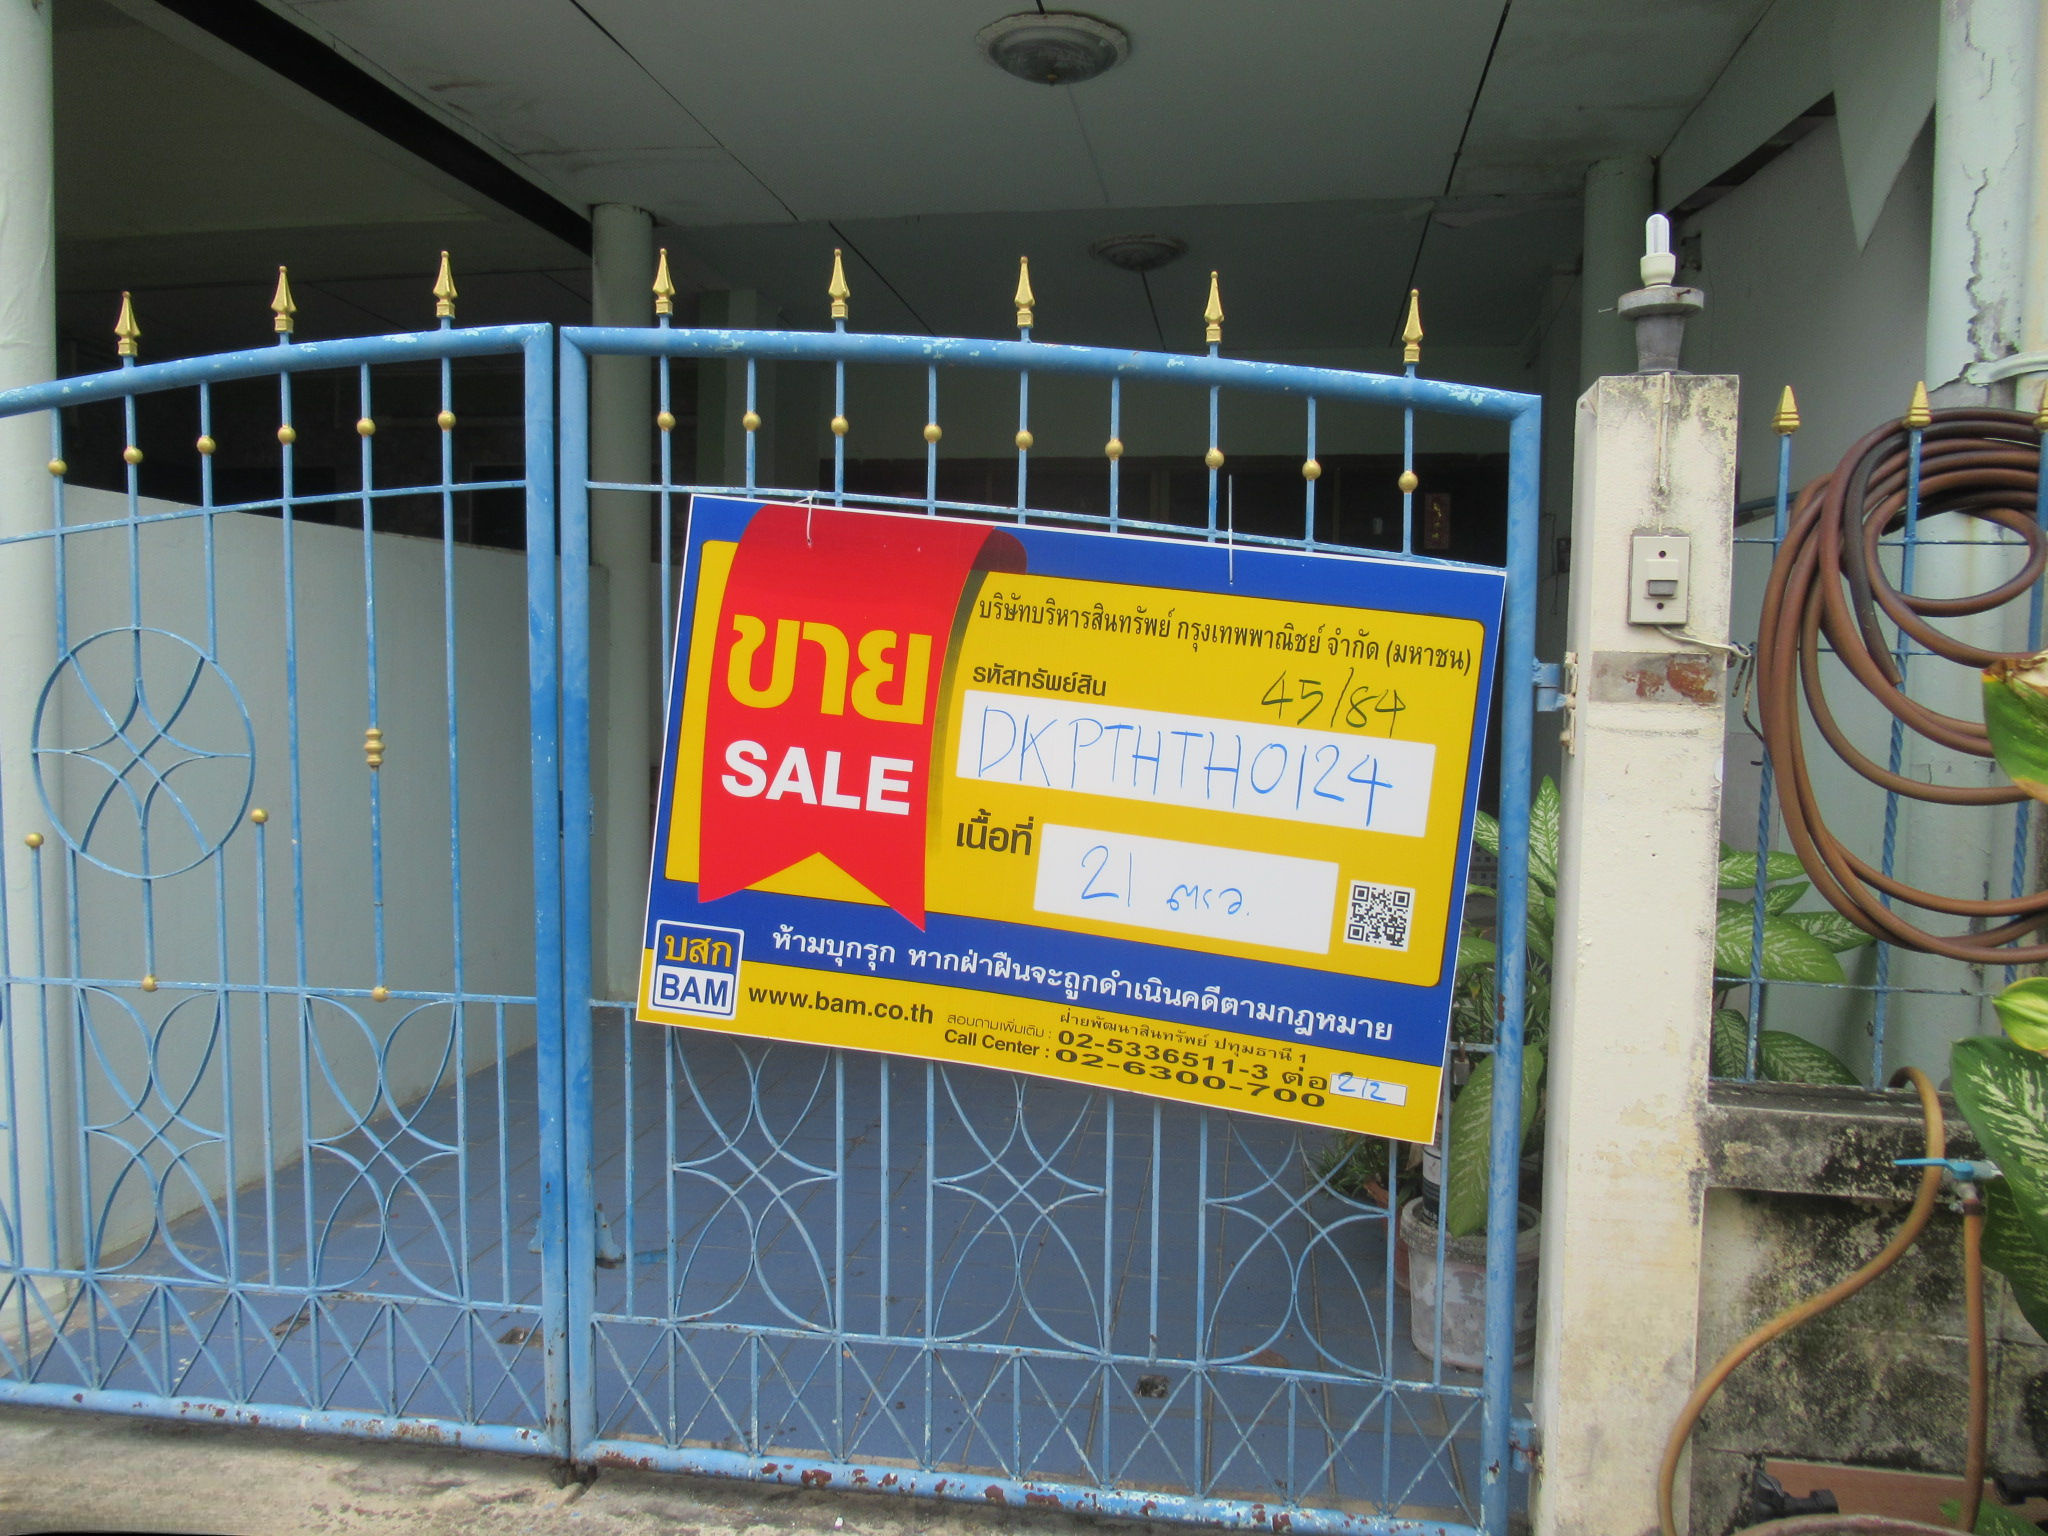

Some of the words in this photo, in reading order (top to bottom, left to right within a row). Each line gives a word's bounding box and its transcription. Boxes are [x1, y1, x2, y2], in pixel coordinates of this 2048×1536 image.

[979, 591, 1176, 638] บริษัทบริหารสินทรัพย์
[1177, 620, 1326, 654] กรุงเทพพาณิชย์
[1327, 627, 1379, 661] จำกัด
[1386, 640, 1471, 676] (มหาชน)
[727, 614, 932, 725] ขาย
[972, 662, 1107, 696] รหัสทรัพย์สิน
[1261, 667, 1406, 738] 45/84
[721, 739, 914, 816] SALE
[956, 808, 1034, 856] เนื้อที่
[1080, 845, 1133, 907] 21
[664, 934, 733, 967] บสก
[772, 923, 896, 971] ห้ามบุกรุก
[908, 946, 1393, 1041] หากฝ่าฝืนจะถูกดำเนินคดีตามกฎหมาย
[660, 973, 729, 1007] BAM
[748, 987, 934, 1024] www.bam.co.th
[944, 1029, 977, 1047] Call
[981, 1034, 1040, 1056] Center
[1055, 1049, 1325, 1108] 02-6300-700
[947, 1014, 1045, 1038] สอบถามเพิ่มเติม
[1058, 1030, 1268, 1080] 02-5336511-3
[1282, 1066, 1327, 1090] ต่อ
[1060, 1008, 1208, 1048] ฝ่ายพัฒนาสินทรัพย์
[1215, 1037, 1292, 1061] ปทุมธานี
[1299, 1054, 1306, 1064] 1
